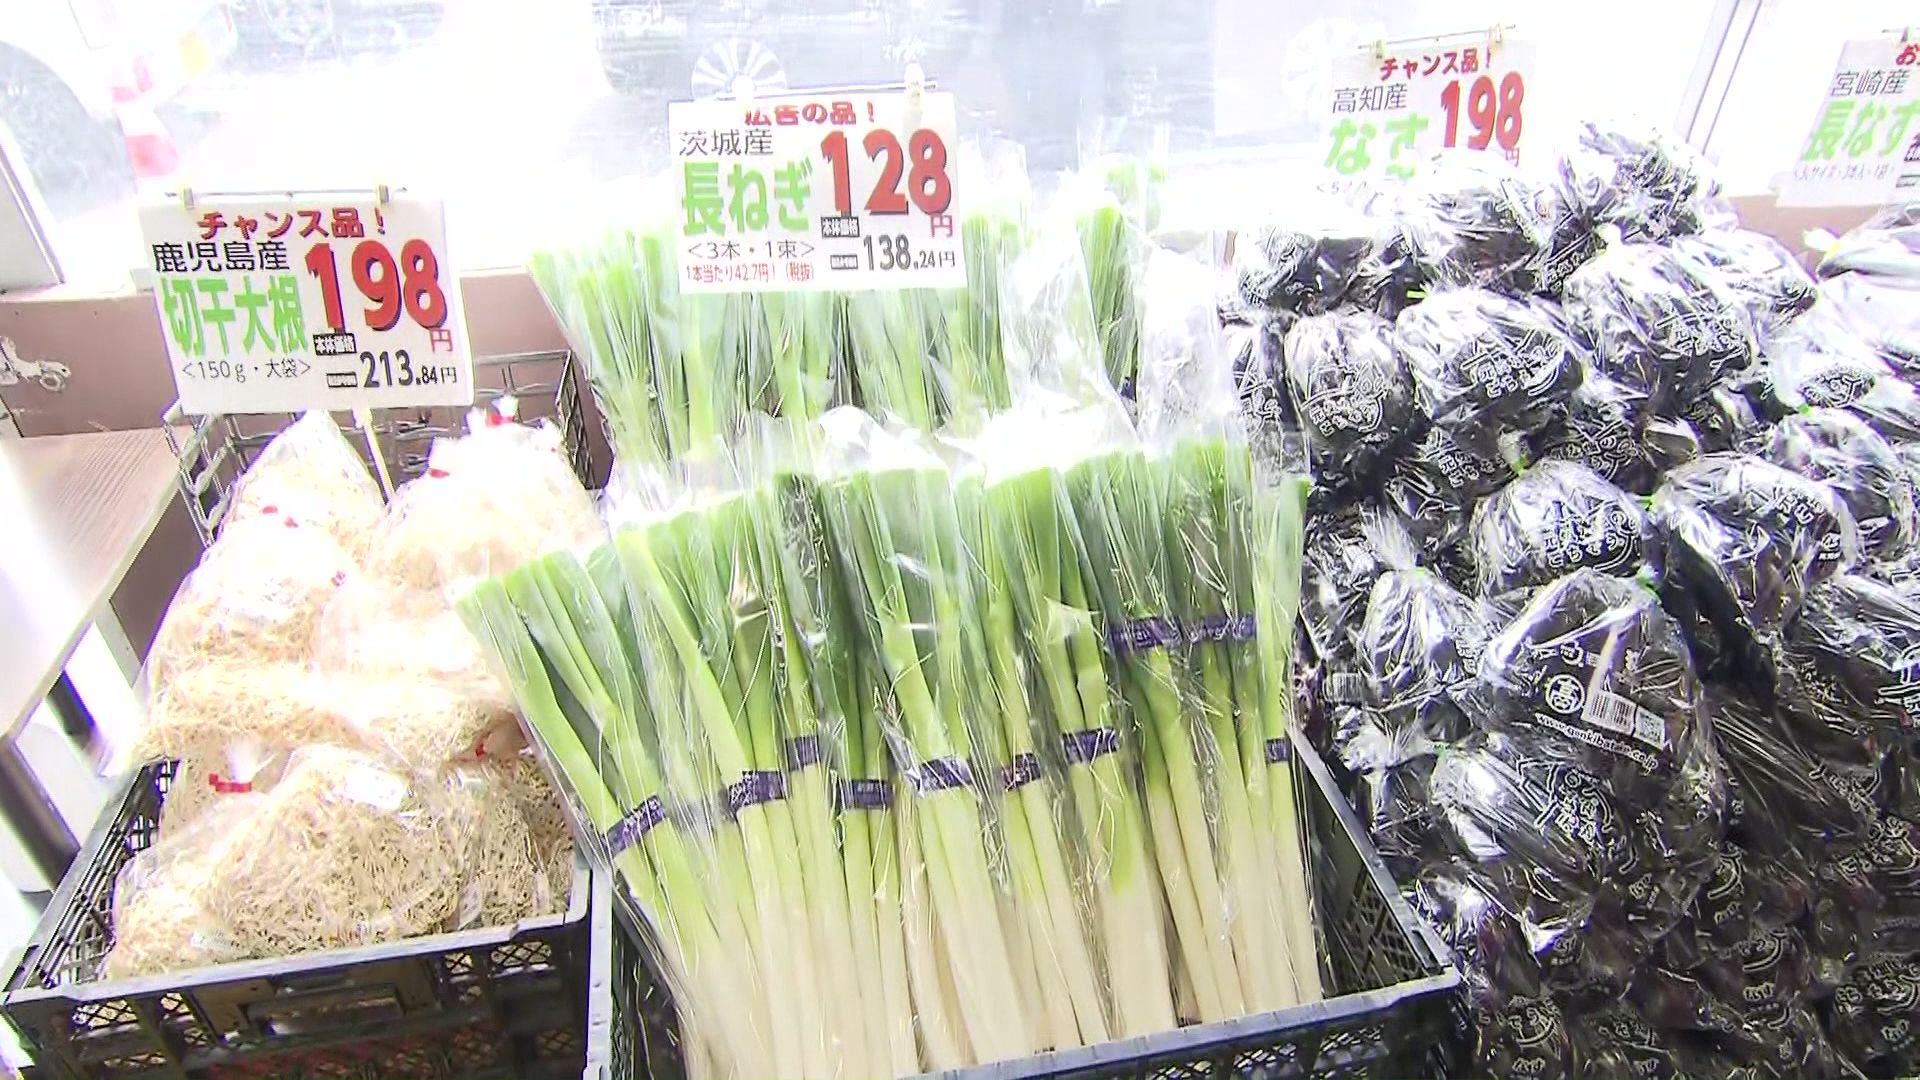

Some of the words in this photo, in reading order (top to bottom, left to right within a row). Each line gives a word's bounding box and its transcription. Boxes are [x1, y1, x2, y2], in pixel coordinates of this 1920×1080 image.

[1332, 83, 1408, 114] 高知産
[1831, 68, 1911, 96] 宮崎産
[1440, 70, 1524, 151] 198
[678, 128, 774, 157] 茨城産
[820, 128, 952, 217] 128
[681, 155, 813, 237] 長ねぎ
[930, 213, 953, 238] 円
[152, 240, 291, 273] 鹿児島産
[304, 237, 447, 334] 198
[161, 273, 309, 357] 切干大根
[430, 328, 453, 353] 円
